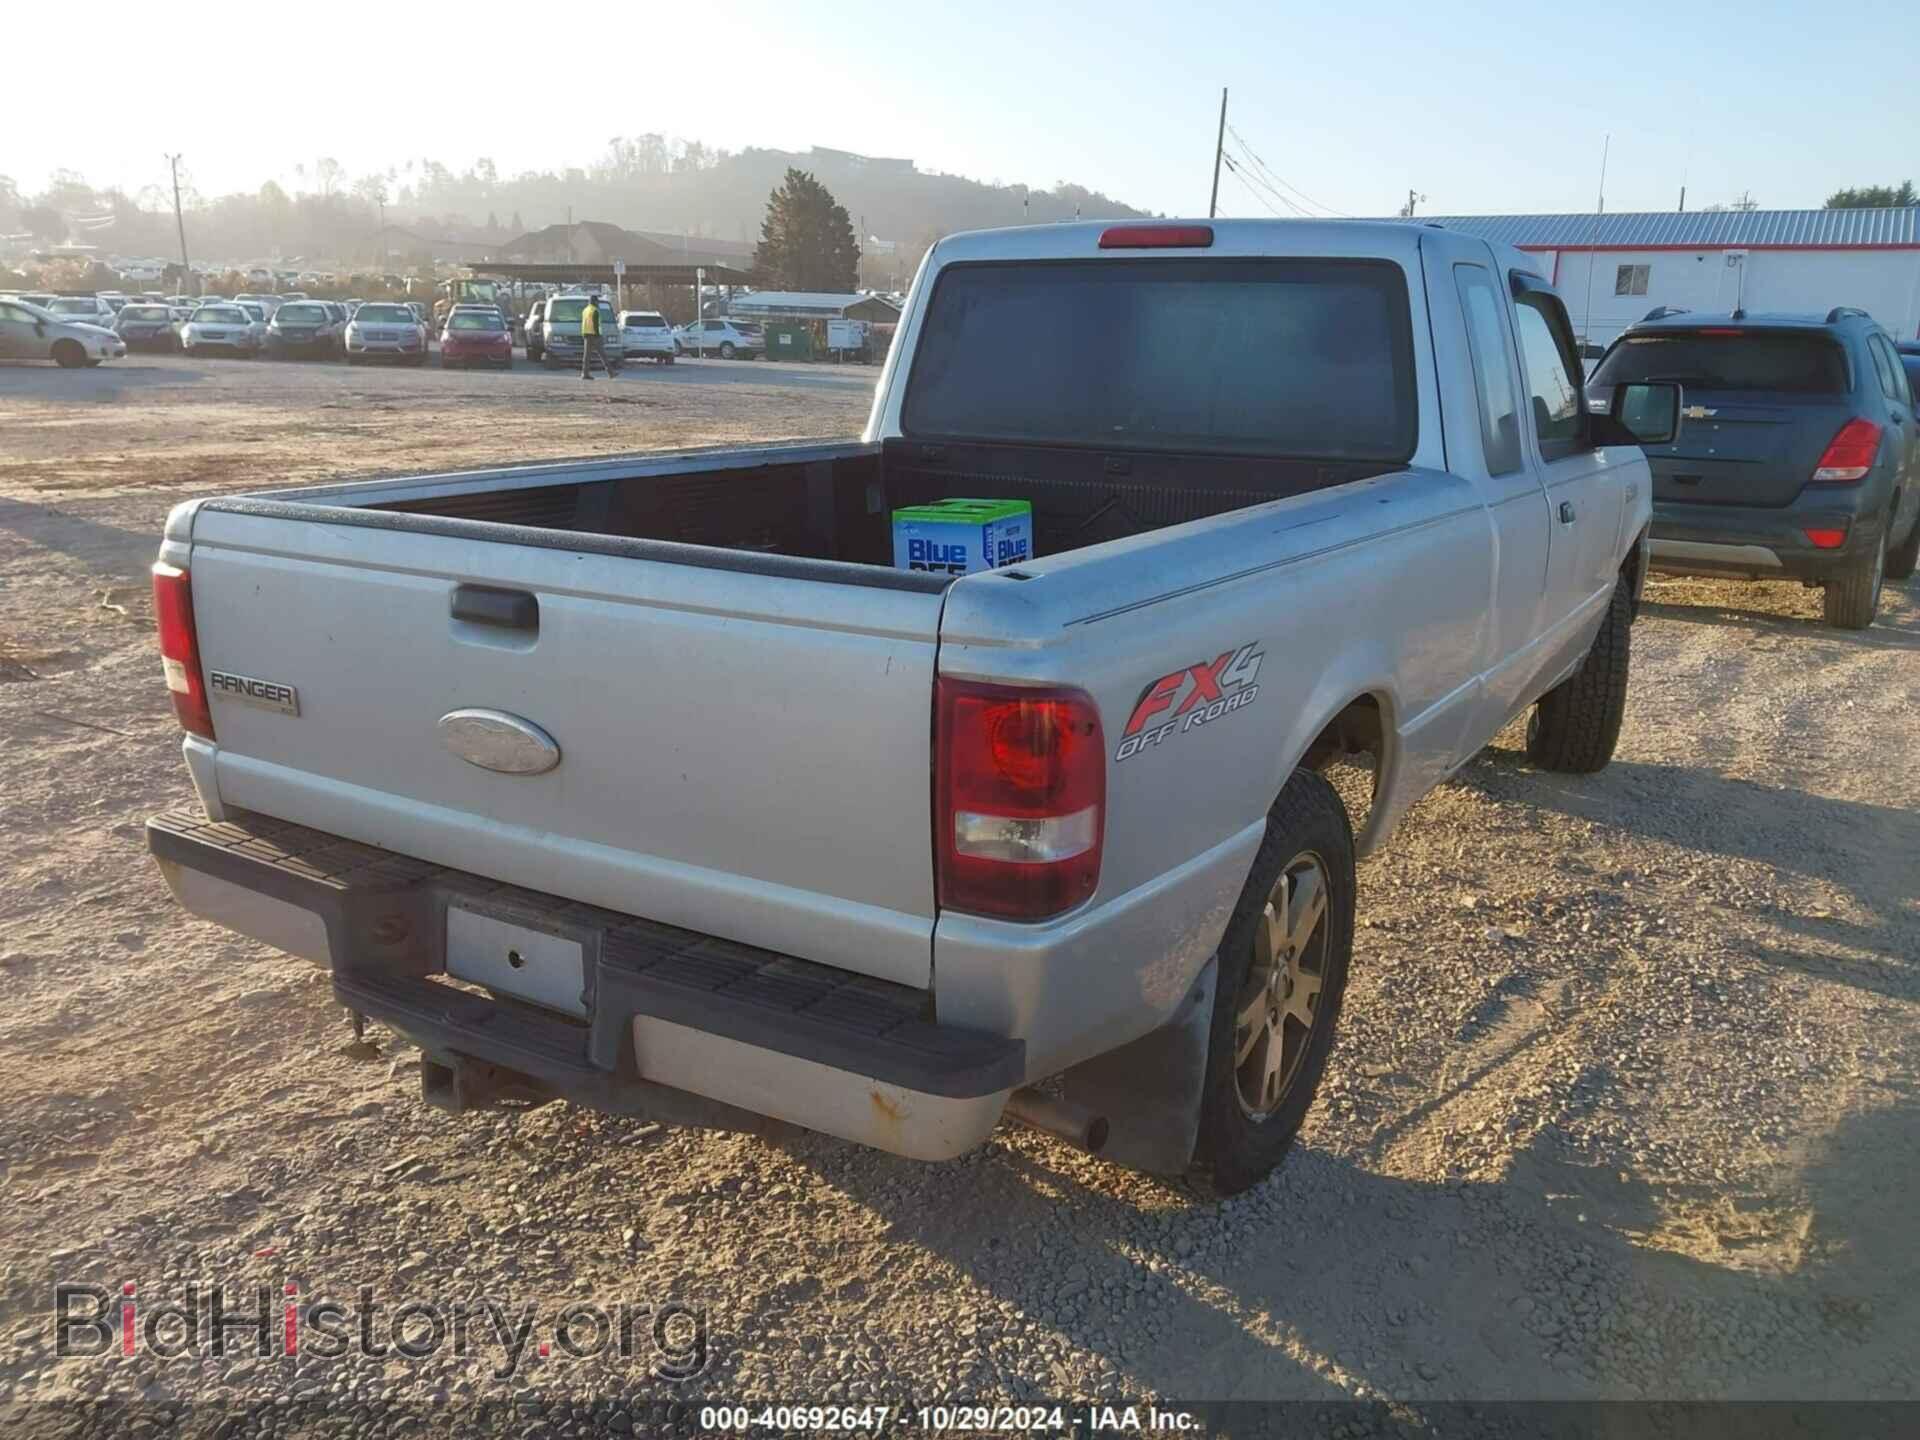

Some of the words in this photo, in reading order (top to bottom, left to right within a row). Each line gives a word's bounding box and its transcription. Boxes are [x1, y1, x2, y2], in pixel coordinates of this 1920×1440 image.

[908, 538, 967, 563] Blue
[998, 538, 1027, 561] Blue
[210, 672, 293, 704] RANGER
[1122, 640, 1265, 740] FX4
[1115, 719, 1178, 763] OFF
[1181, 685, 1260, 734] ROAD
